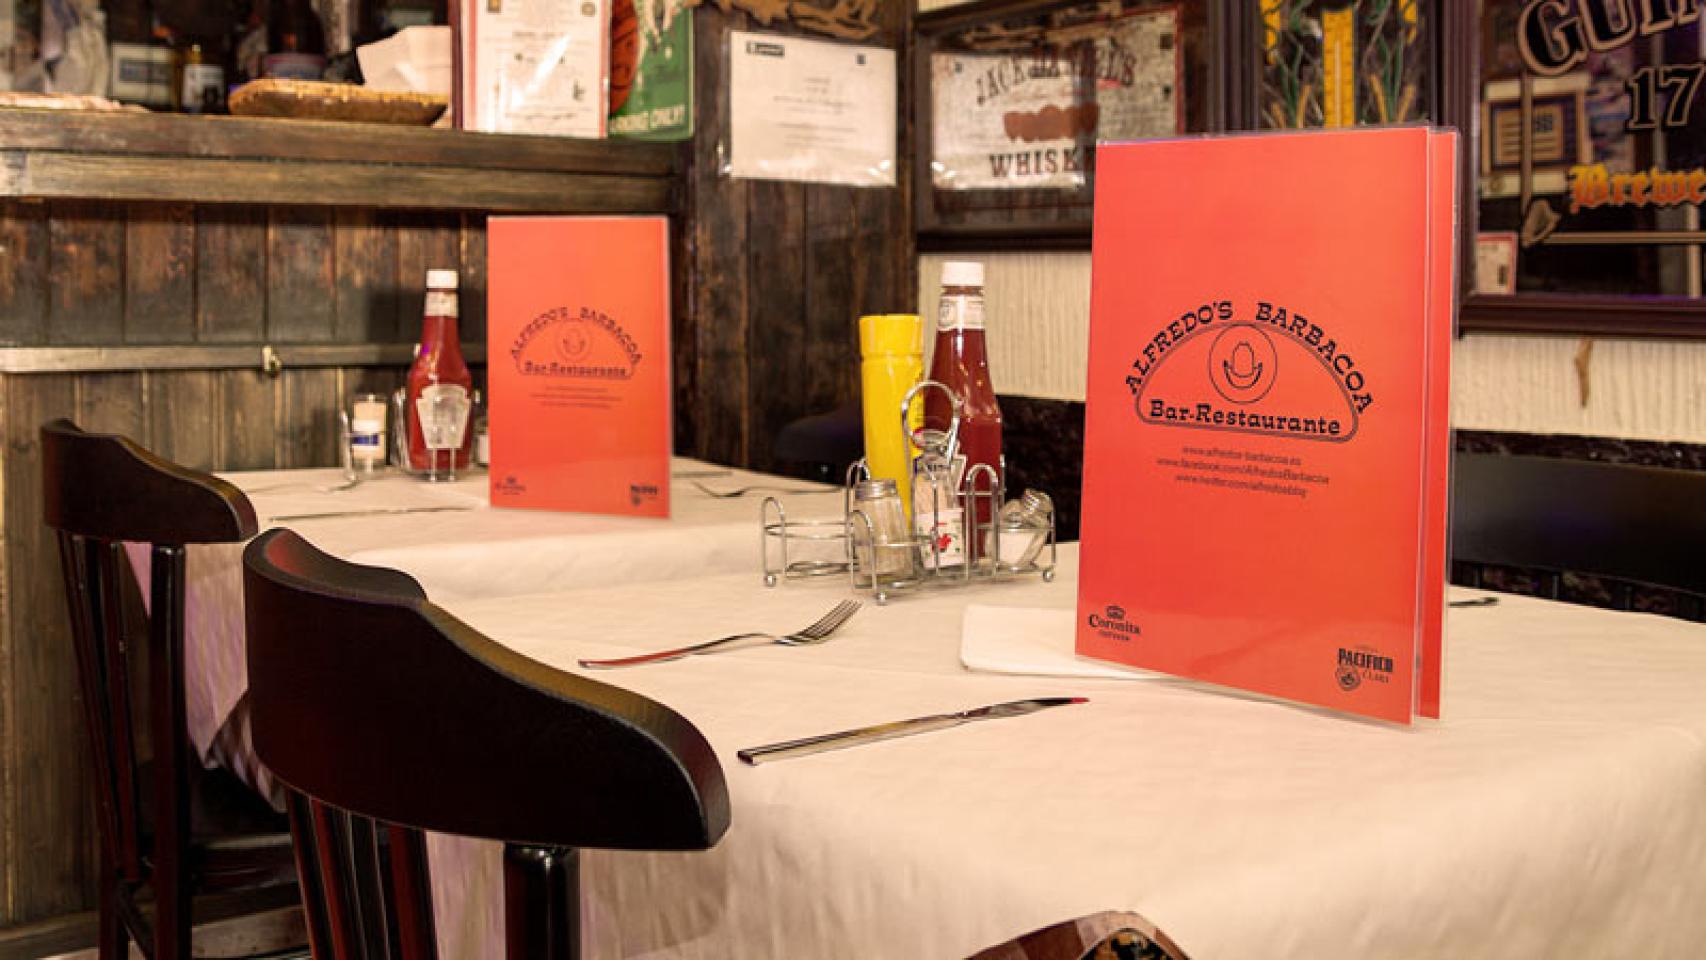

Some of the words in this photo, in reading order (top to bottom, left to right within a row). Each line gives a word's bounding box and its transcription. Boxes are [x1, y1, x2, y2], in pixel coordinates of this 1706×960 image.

[1627, 61, 1706, 129] 17
[1125, 301, 1233, 395] ALFREDO'S
[1255, 302, 1374, 414] BARBACOA
[1149, 399, 1341, 434] Bar-Restaurante
